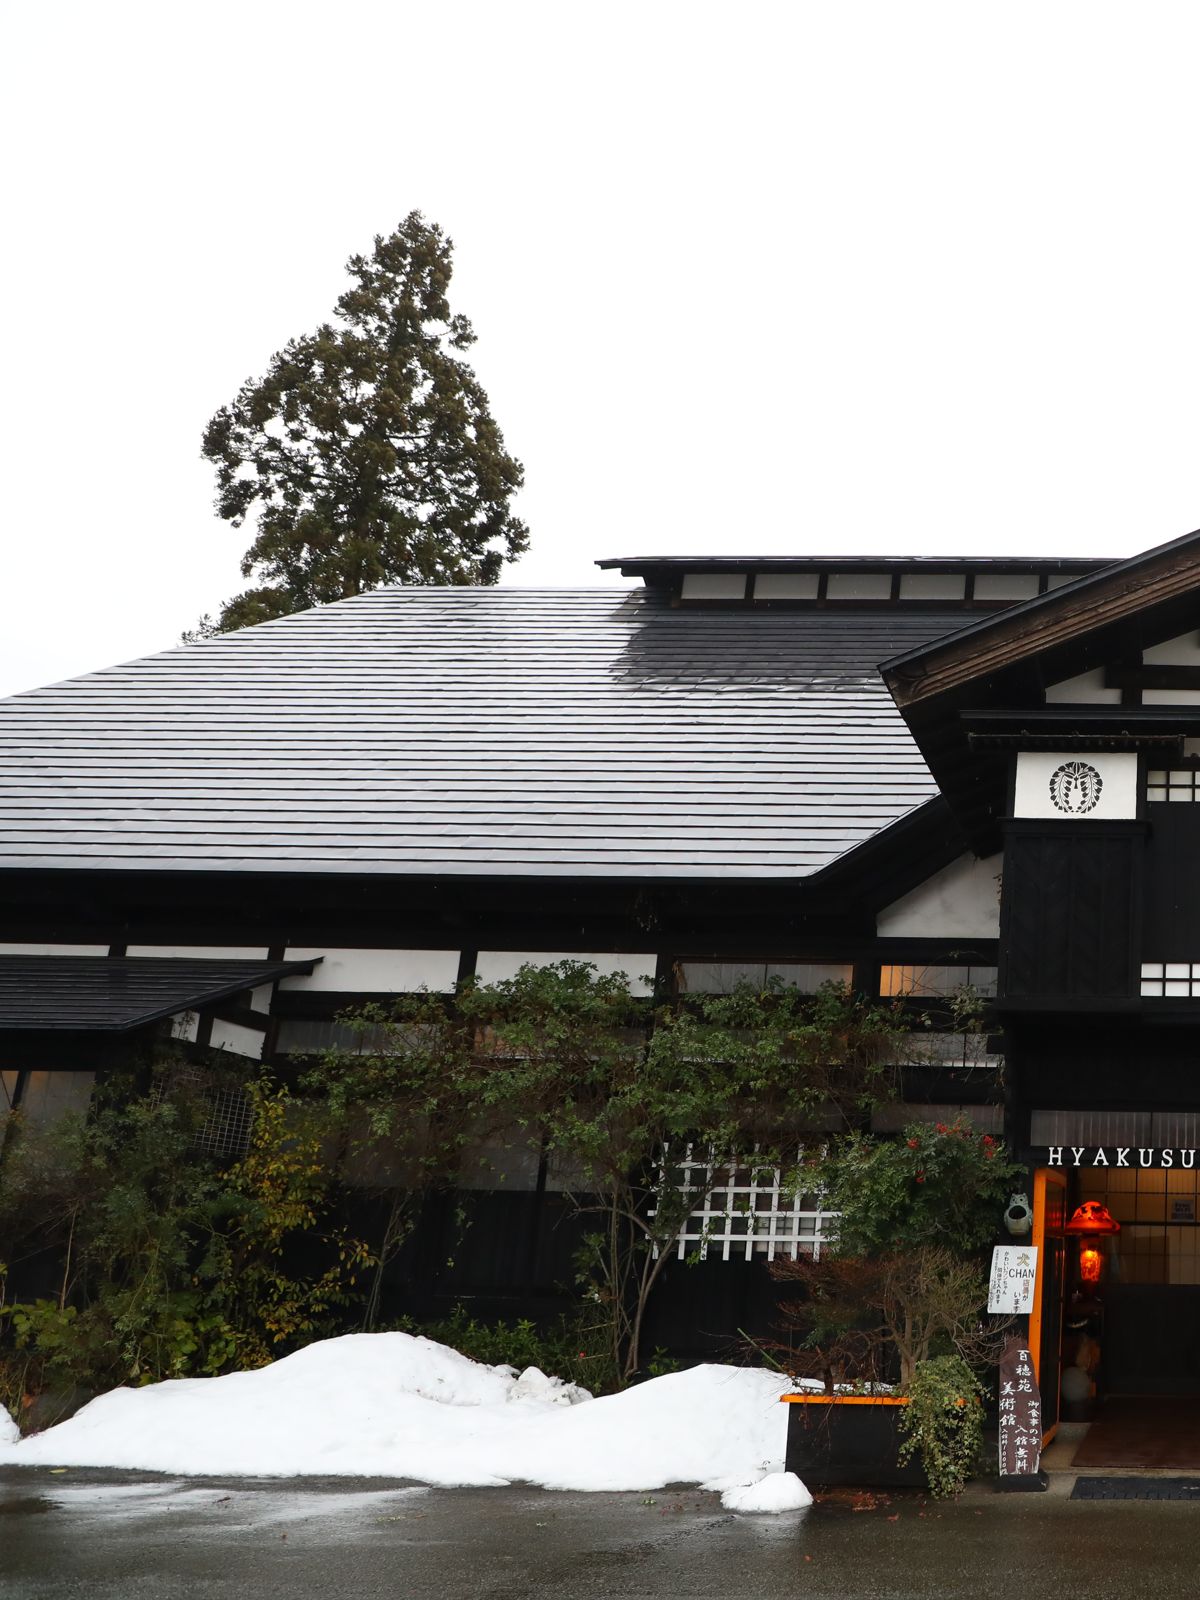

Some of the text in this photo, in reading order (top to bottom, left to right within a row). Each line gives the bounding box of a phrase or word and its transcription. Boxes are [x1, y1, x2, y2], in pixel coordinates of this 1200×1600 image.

[1008, 1268, 1035, 1278] CHAN
[1017, 1252, 1030, 1267] 犬
[1015, 1349, 1032, 1393] 百穂苑
[1000, 1381, 1017, 1426] 美術館
[1027, 1400, 1040, 1445] 御食事の方
[1014, 1425, 1029, 1471] 入館無料
